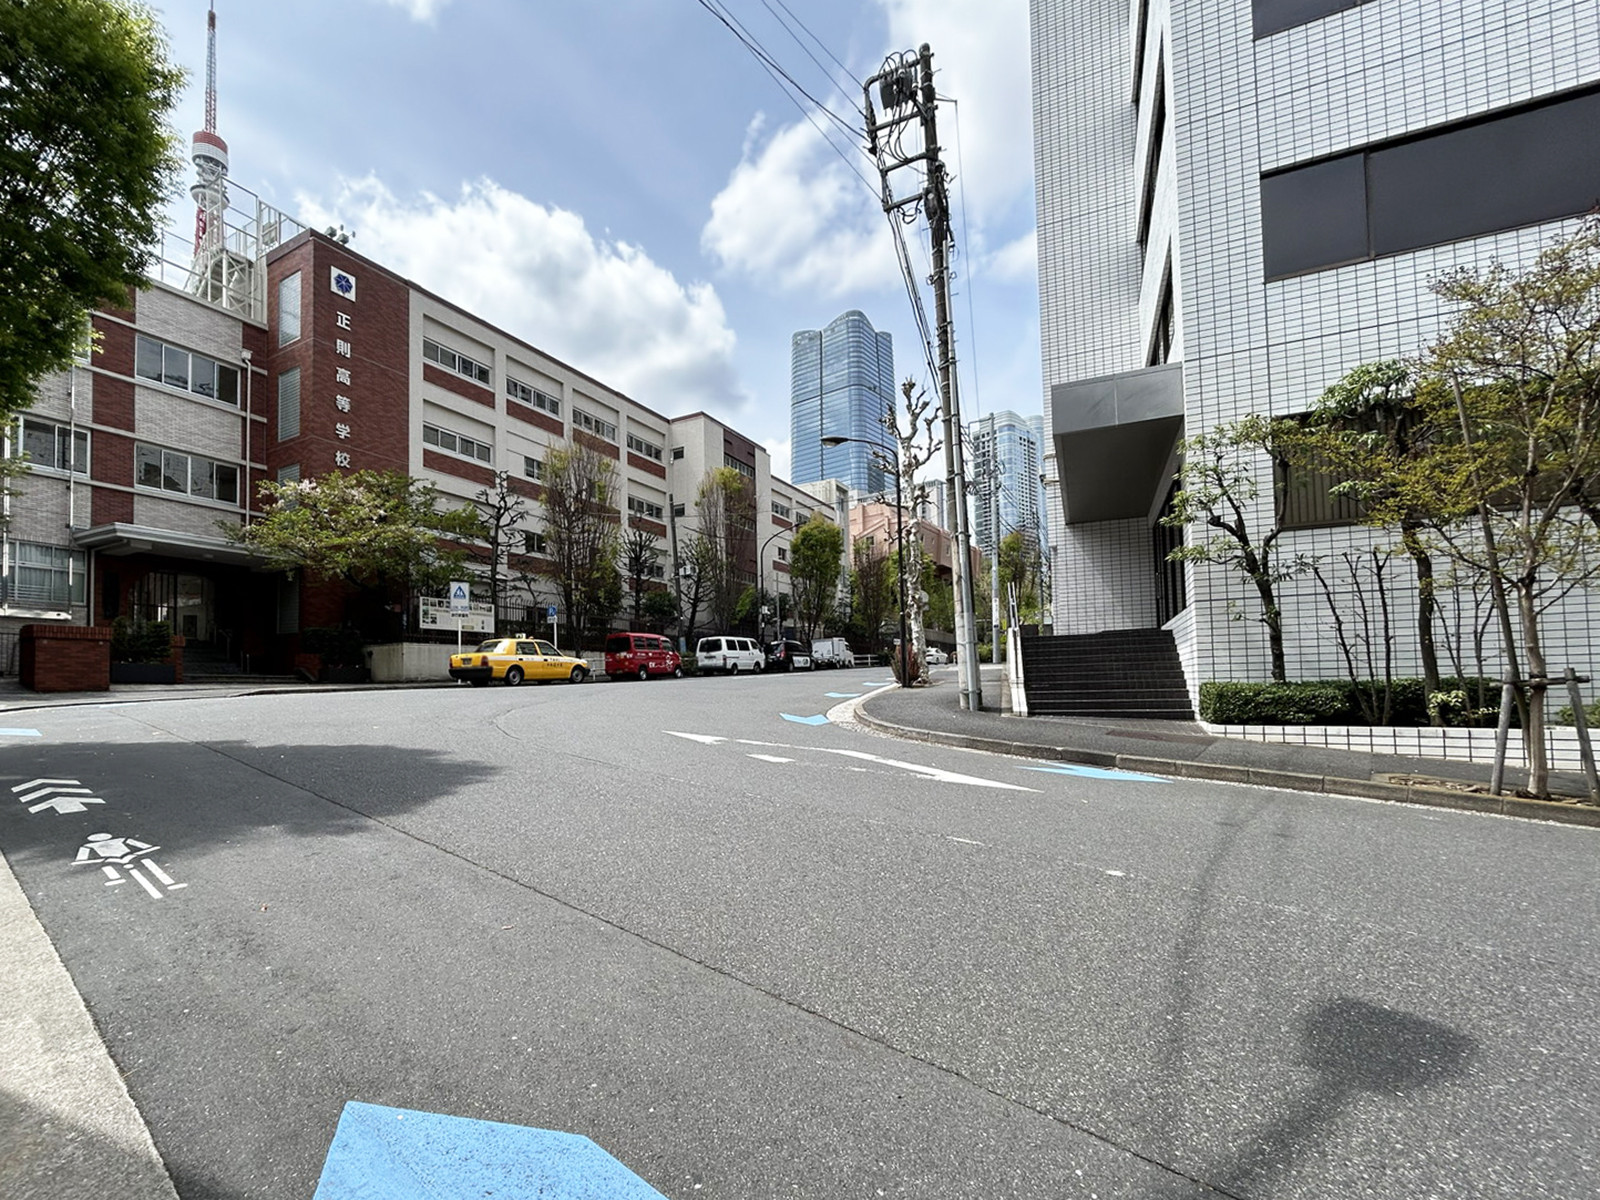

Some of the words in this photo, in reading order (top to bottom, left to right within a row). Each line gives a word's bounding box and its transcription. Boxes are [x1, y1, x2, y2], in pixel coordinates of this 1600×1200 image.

[335, 311, 351, 468] 正則高等学校
